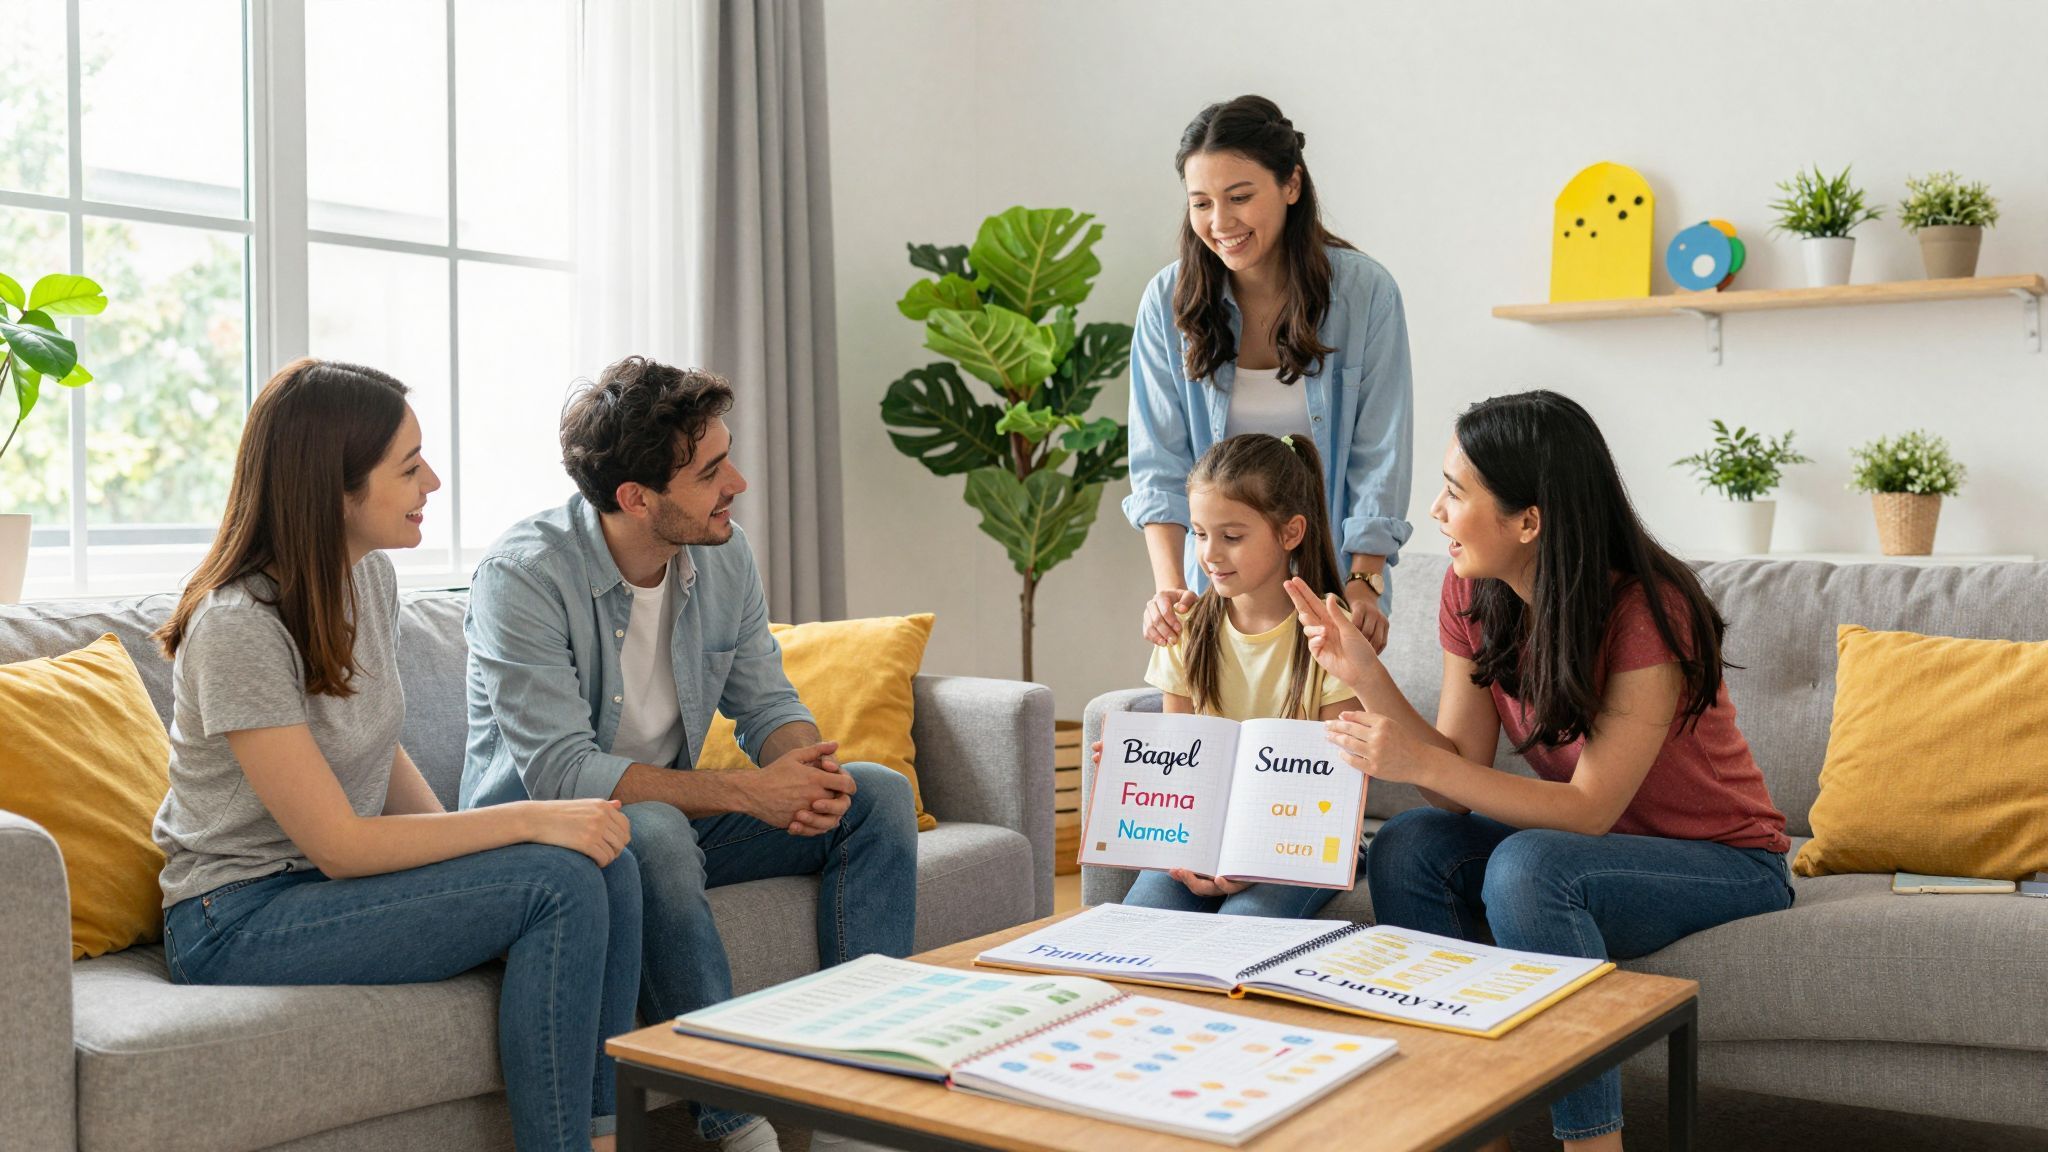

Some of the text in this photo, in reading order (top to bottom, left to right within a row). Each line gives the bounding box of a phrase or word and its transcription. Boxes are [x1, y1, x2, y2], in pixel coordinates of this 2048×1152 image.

[1122, 738, 1202, 776] Bagel
[1254, 746, 1335, 776] Suma
[1121, 781, 1195, 810] Fanna
